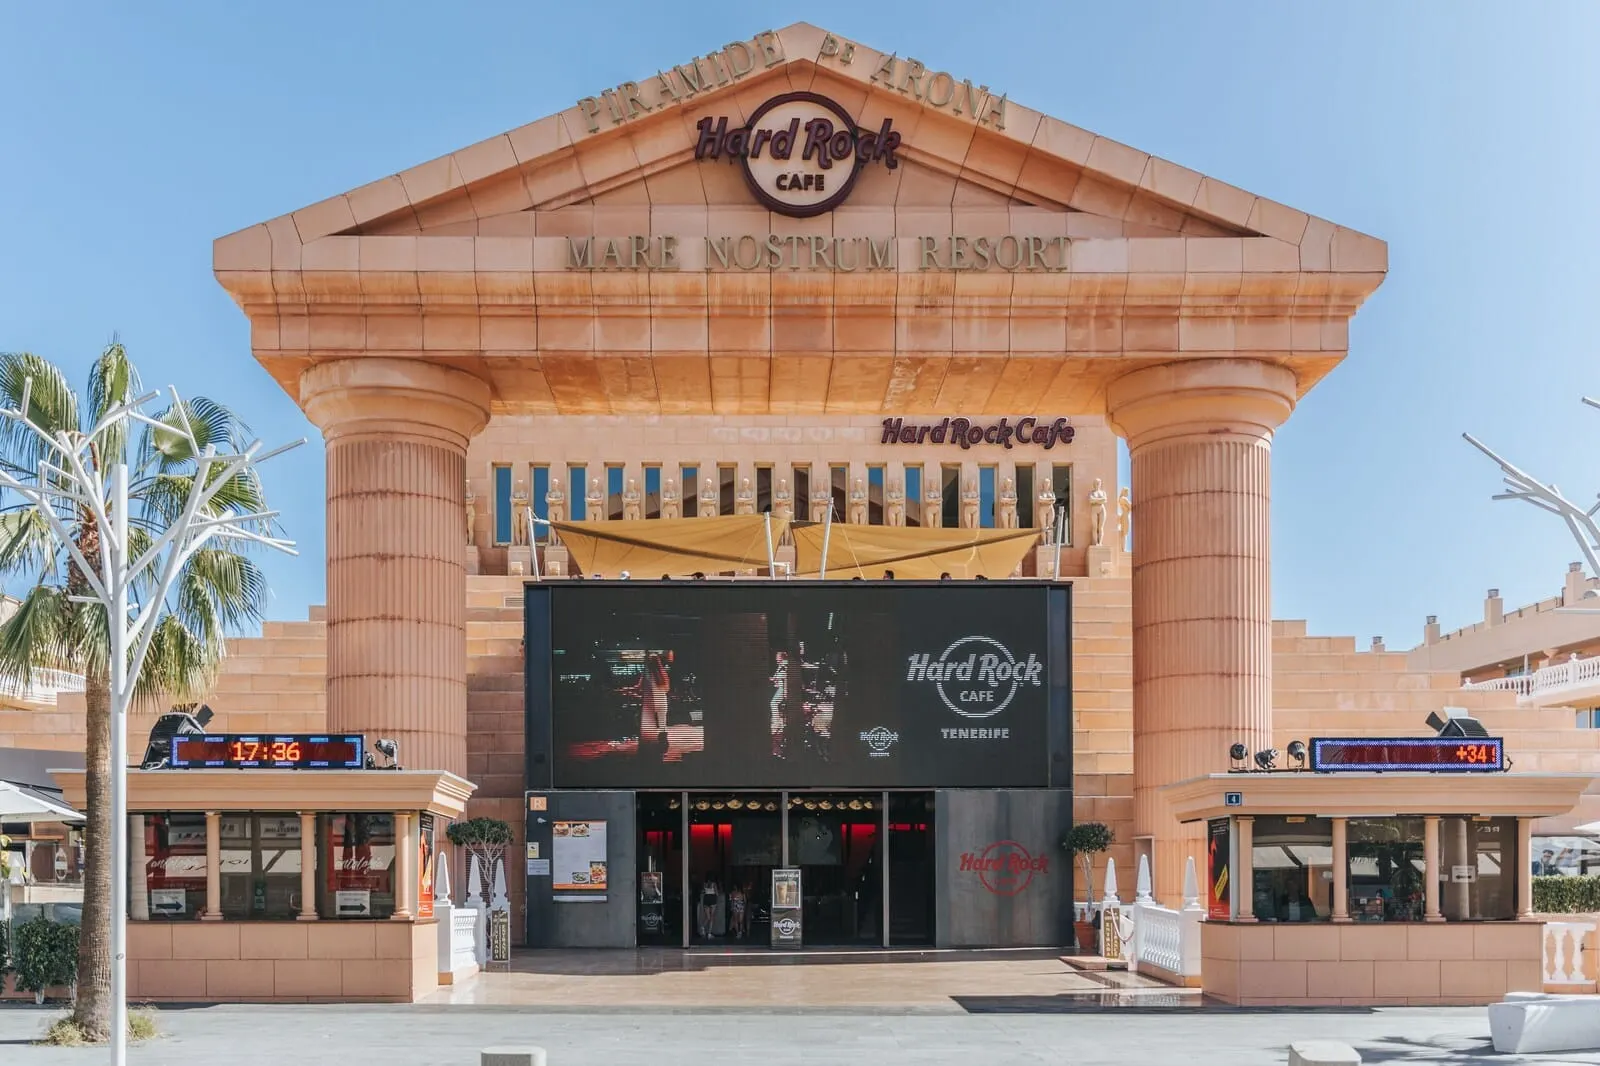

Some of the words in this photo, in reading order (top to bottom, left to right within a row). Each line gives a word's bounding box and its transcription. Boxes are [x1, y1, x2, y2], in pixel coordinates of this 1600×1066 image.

[577, 30, 785, 133] PIRAMIDE
[820, 32, 856, 66] DE
[870, 51, 1008, 131] ARONA
[695, 116, 800, 161] Hard
[802, 118, 901, 169] Rock
[776, 174, 825, 191] CAFE
[565, 235, 680, 272] MARE
[704, 235, 895, 272] NOSTRUM
[918, 235, 1073, 272] RESORT
[881, 417, 949, 444] Hard
[949, 417, 1014, 450] Rock
[1015, 417, 1075, 450] Cafe
[907, 653, 976, 681] Hard
[978, 653, 1043, 687] Rock
[959, 690, 994, 702] CAFE
[941, 728, 1010, 739] TENERIFE
[232, 742, 300, 761] 17:36
[960, 852, 1007, 871] Hard
[1007, 852, 1049, 874] Rock
